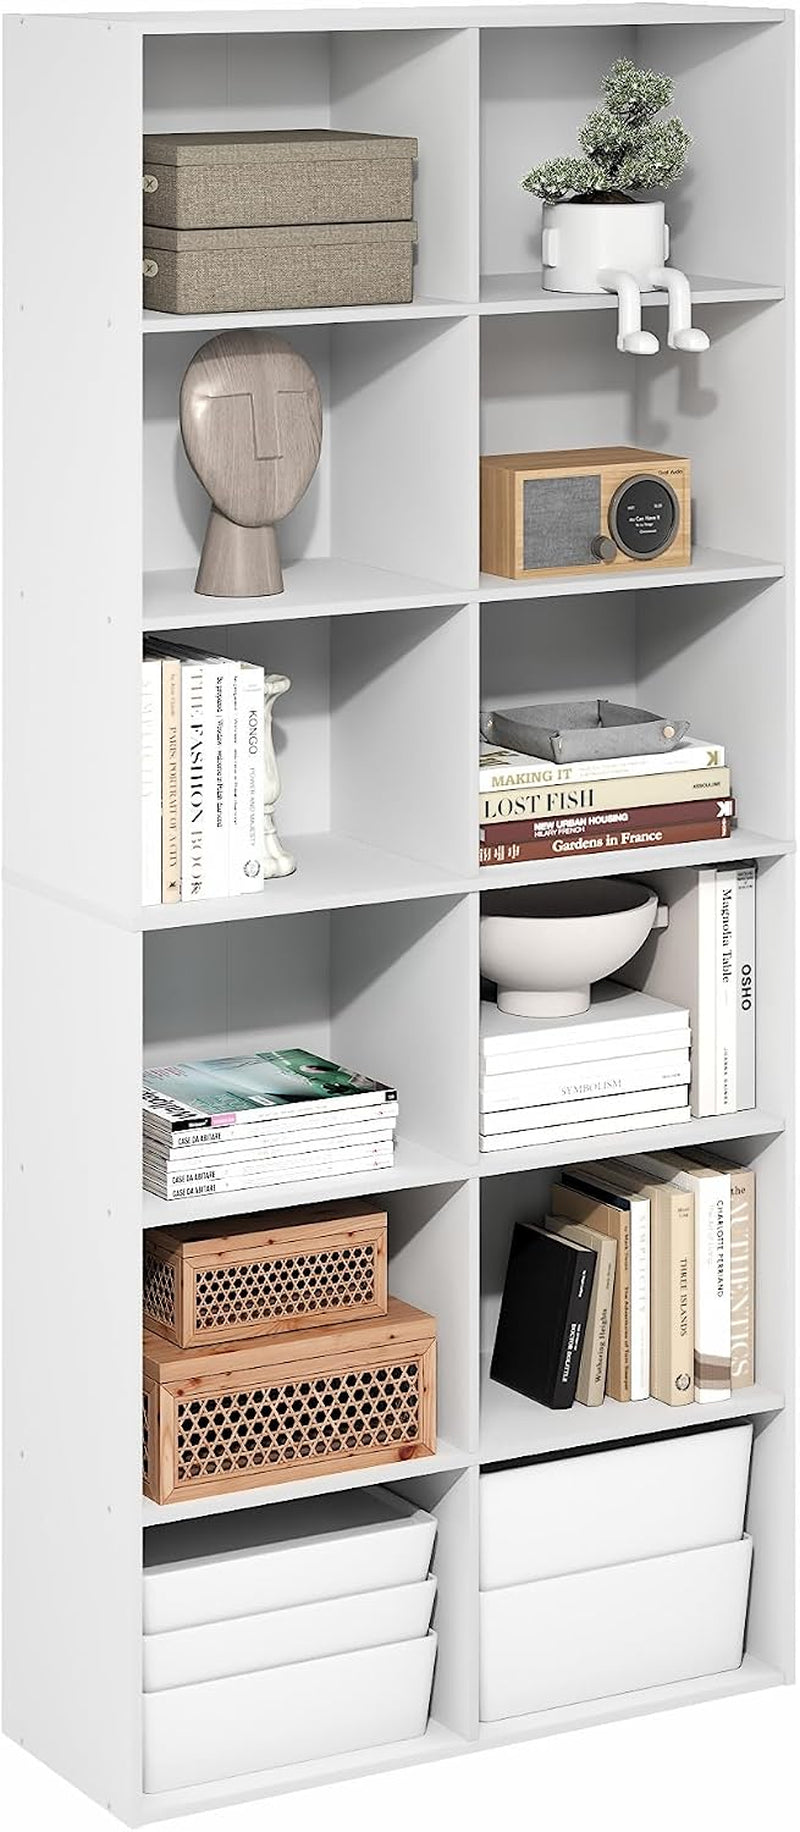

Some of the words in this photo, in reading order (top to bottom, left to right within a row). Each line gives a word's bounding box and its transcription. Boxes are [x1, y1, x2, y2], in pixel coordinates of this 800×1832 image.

[190, 668, 203, 718] THE
[248, 710, 258, 755] KONGO
[169, 762, 177, 815] PORTRAIT
[190, 723, 203, 823] FASHION
[491, 769, 553, 788] MAKING
[557, 768, 573, 780] IT
[485, 794, 541, 818] LOST
[547, 789, 594, 811] FISH
[169, 818, 177, 829] OF
[533, 820, 555, 831] NEW
[556, 818, 587, 829] URBAN
[588, 812, 629, 826] HOUSING
[534, 828, 557, 838] HILARY
[558, 826, 586, 835] FRENCH
[169, 844, 177, 867] CITY
[552, 838, 604, 852] Gardens
[606, 834, 619, 846] in
[620, 831, 663, 845] France
[190, 831, 203, 895] BOOK
[721, 888, 732, 947] Magnolia
[722, 949, 732, 984] Table
[741, 964, 752, 1011] OSHO
[560, 1079, 623, 1096] SYMBOLISM
[178, 1136, 191, 1145] CASE
[192, 1135, 199, 1143] DA
[172, 1175, 185, 1184] CASE
[186, 1173, 194, 1182] DA
[172, 1188, 185, 1197] CASE
[187, 1187, 194, 1195] DA
[730, 1186, 746, 1195] the
[679, 1257, 688, 1293] THREE
[730, 1202, 749, 1377] AUTHENTICS
[598, 1308, 608, 1340] Heights
[679, 1294, 688, 1337] ISLANDS
[567, 1323, 577, 1351] DOCTOR
[562, 1350, 573, 1383] DOLITTLE
[595, 1342, 606, 1384] Wuthering
